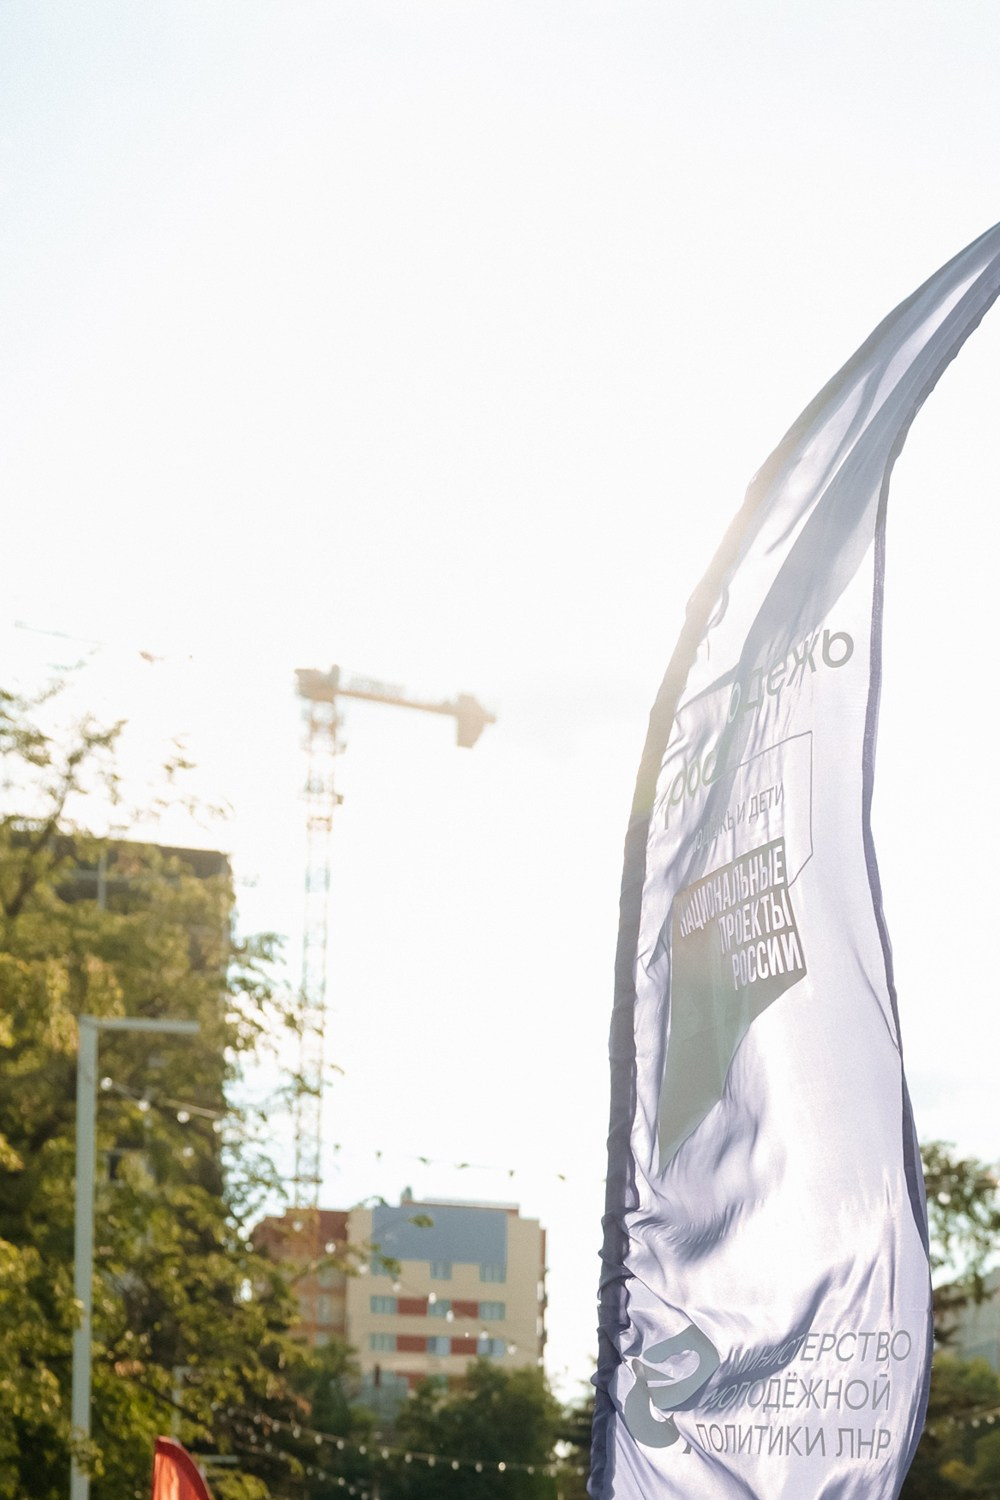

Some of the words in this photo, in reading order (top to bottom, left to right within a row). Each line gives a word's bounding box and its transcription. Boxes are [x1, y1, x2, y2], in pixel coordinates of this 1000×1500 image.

[736, 801, 746, 825] И
[749, 781, 785, 824] ДЕТИ
[680, 845, 786, 938] НАЦИОНАЛЬНЫЕ
[718, 888, 793, 955] ПРОЕКТЫ
[732, 931, 803, 990] РОССИИ
[727, 1330, 912, 1376] МИНИСТЕРСТВО
[698, 1372, 891, 1413] МОЛОДЁЖНОЙ
[696, 1424, 826, 1457] ПОЛИТИКИ
[836, 1428, 892, 1459] ЛНР
